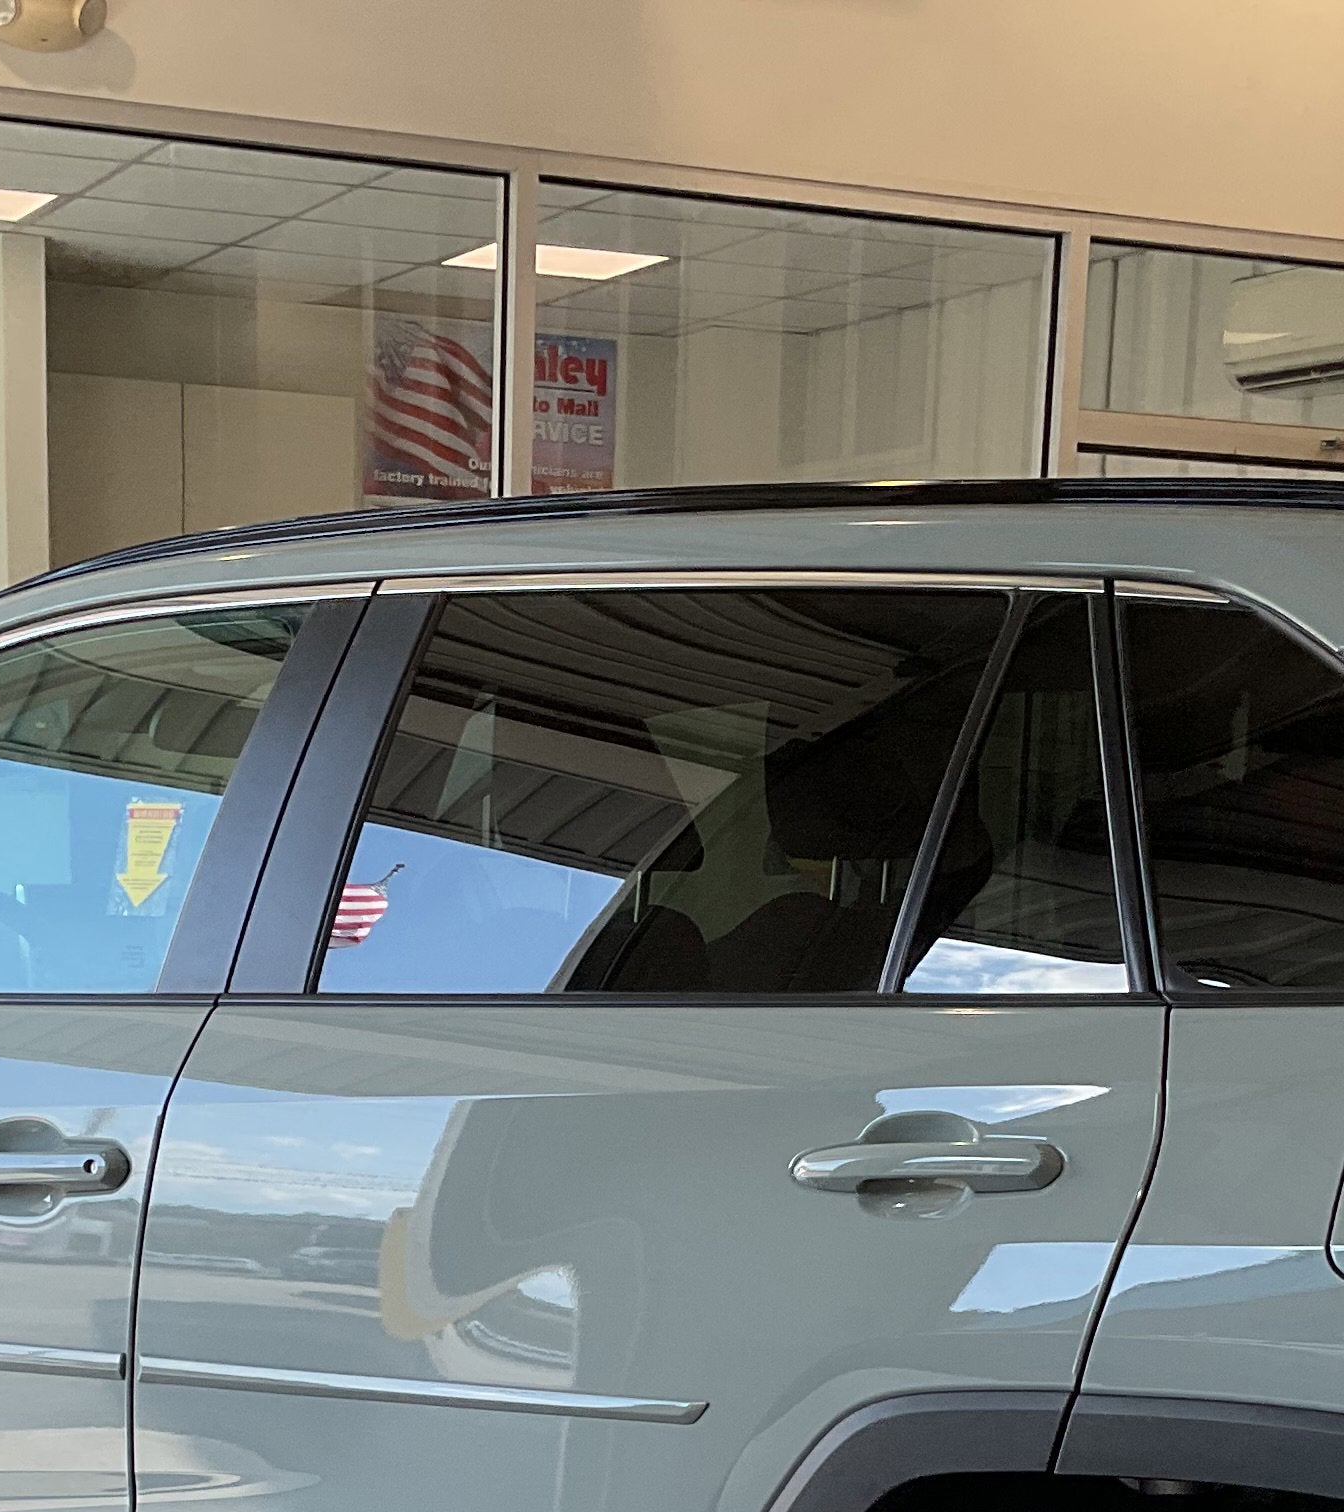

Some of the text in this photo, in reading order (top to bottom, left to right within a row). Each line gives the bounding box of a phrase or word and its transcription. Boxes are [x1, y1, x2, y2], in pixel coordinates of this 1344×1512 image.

[534, 343, 608, 397] ley
[533, 397, 599, 417] to Mall
[533, 420, 604, 446] RVICE
[374, 469, 424, 486] factory
